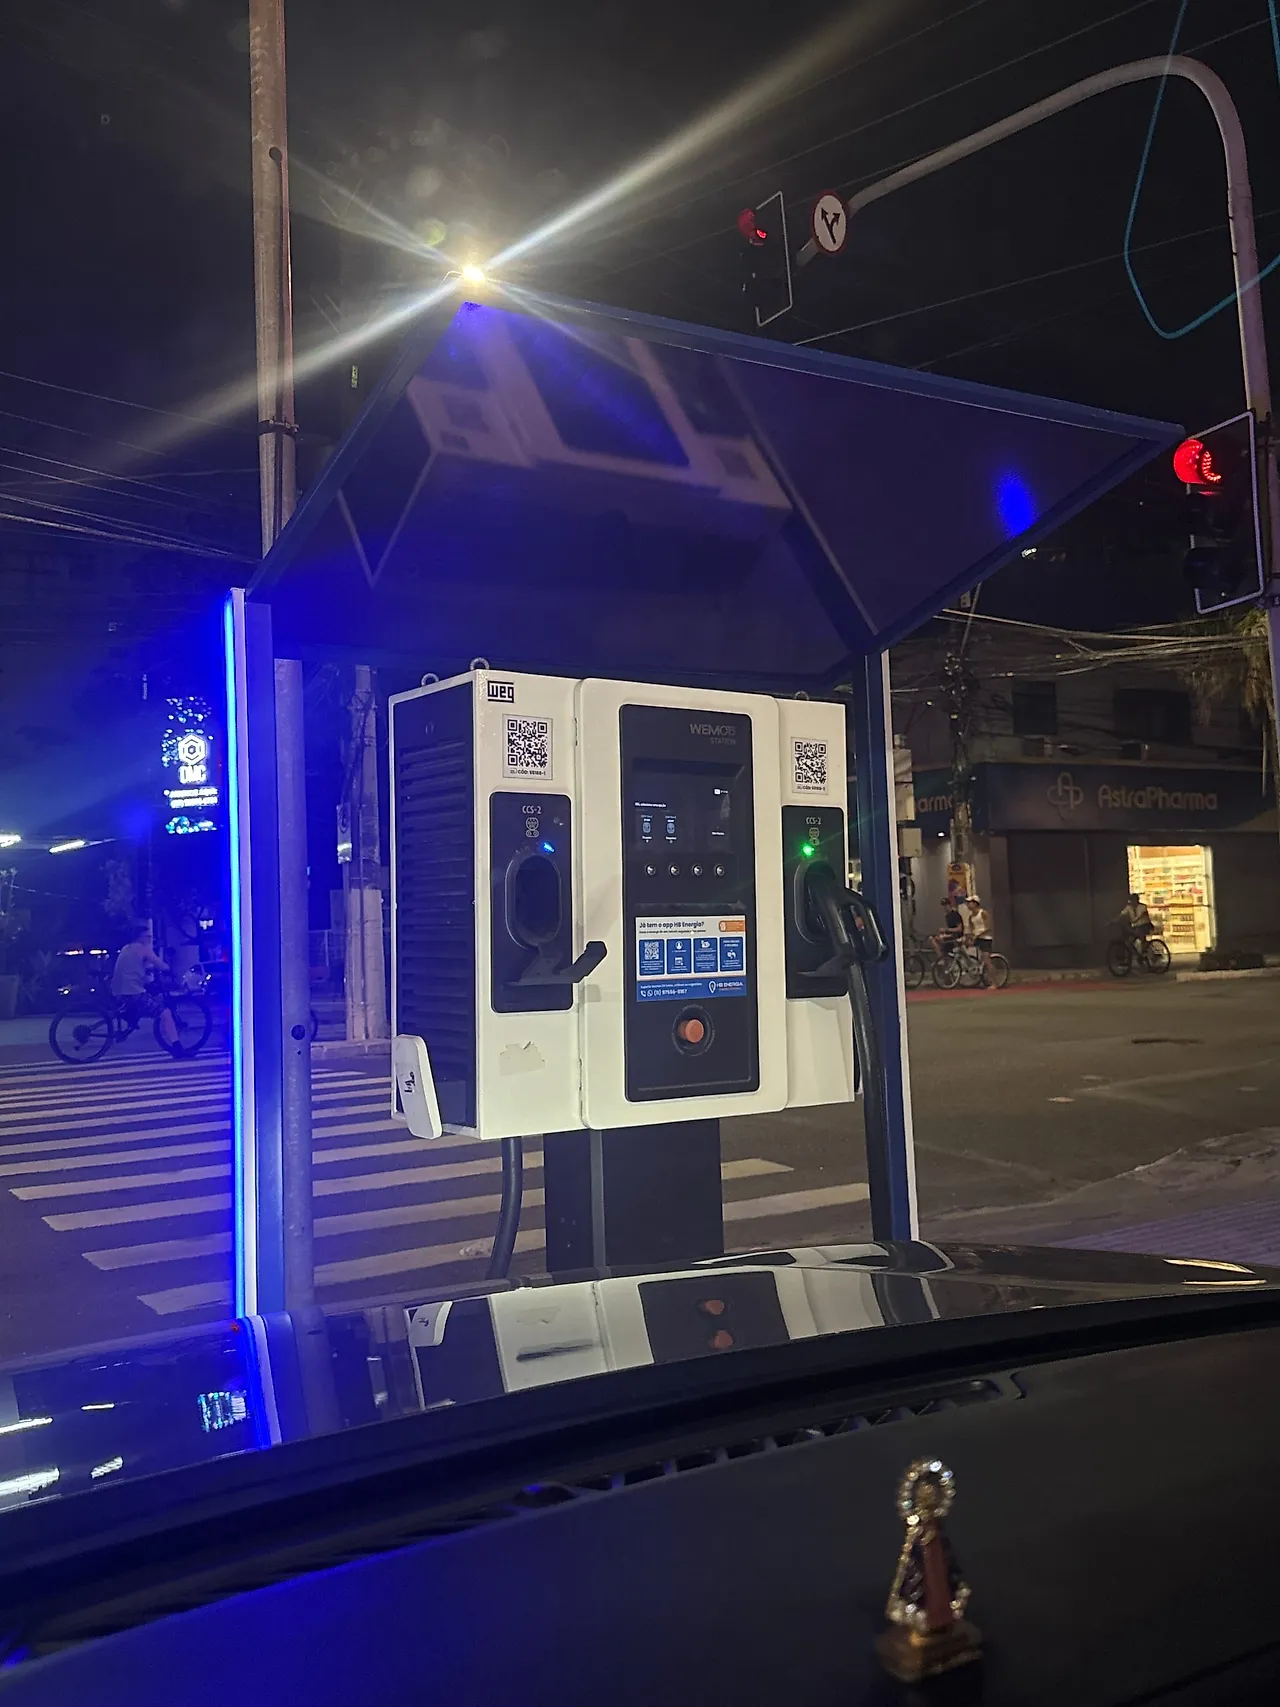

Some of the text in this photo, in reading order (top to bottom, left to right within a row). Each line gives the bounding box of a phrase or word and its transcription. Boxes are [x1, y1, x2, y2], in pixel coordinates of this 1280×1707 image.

[1098, 784, 1218, 810] AstraPharma
[522, 805, 542, 814] CCS-2
[805, 816, 822, 825] CCS-2
